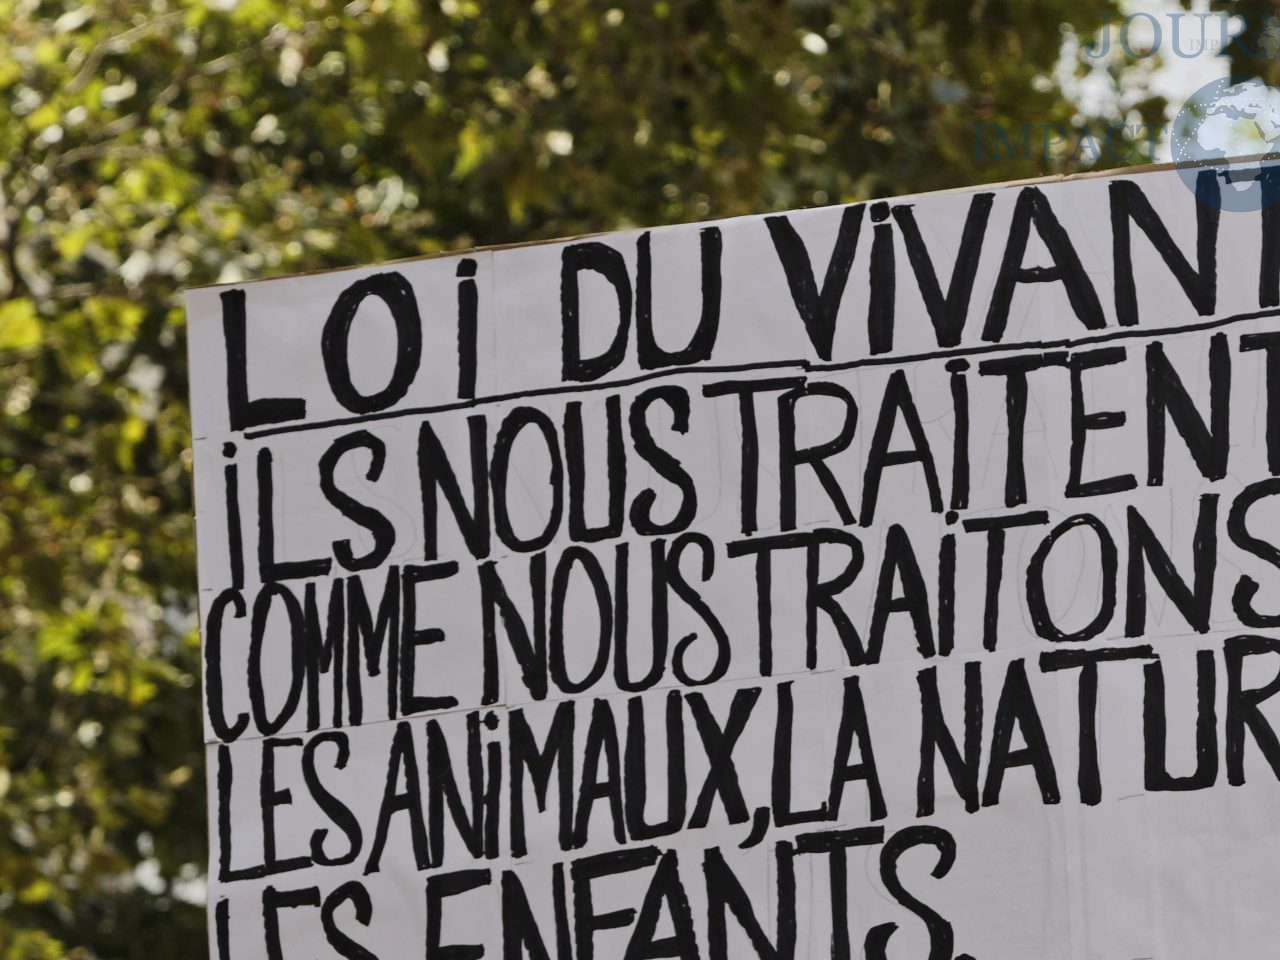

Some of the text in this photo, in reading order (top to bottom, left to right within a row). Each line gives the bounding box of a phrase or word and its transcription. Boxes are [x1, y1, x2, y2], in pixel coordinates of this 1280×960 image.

[561, 226, 722, 382] DU
[417, 385, 698, 560] NOUS
[205, 561, 459, 742] COMME
[477, 532, 731, 706] NOUS
[217, 731, 362, 883] LES
